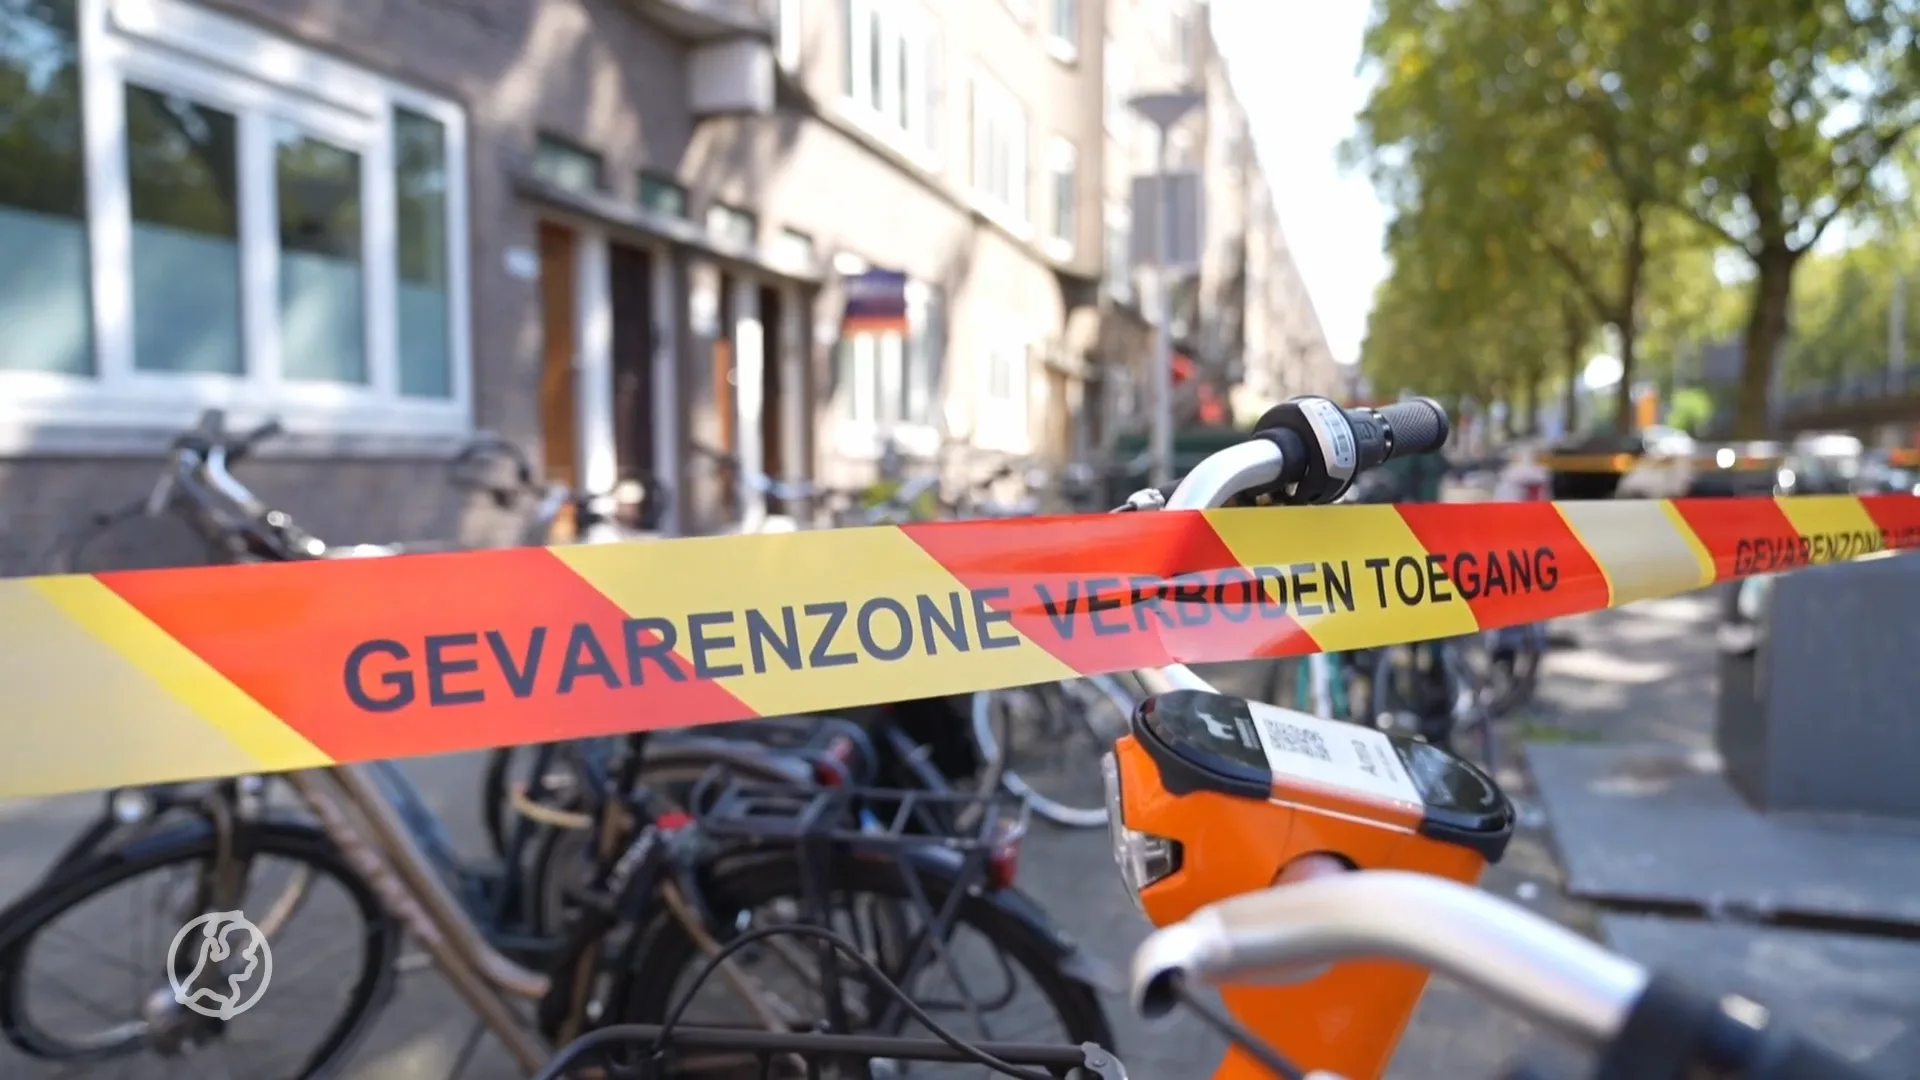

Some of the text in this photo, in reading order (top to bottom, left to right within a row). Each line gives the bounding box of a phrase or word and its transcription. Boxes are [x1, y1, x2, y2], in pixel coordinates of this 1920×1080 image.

[343, 546, 1559, 713] GEVARENZONE VERBODEN TOEGANG
